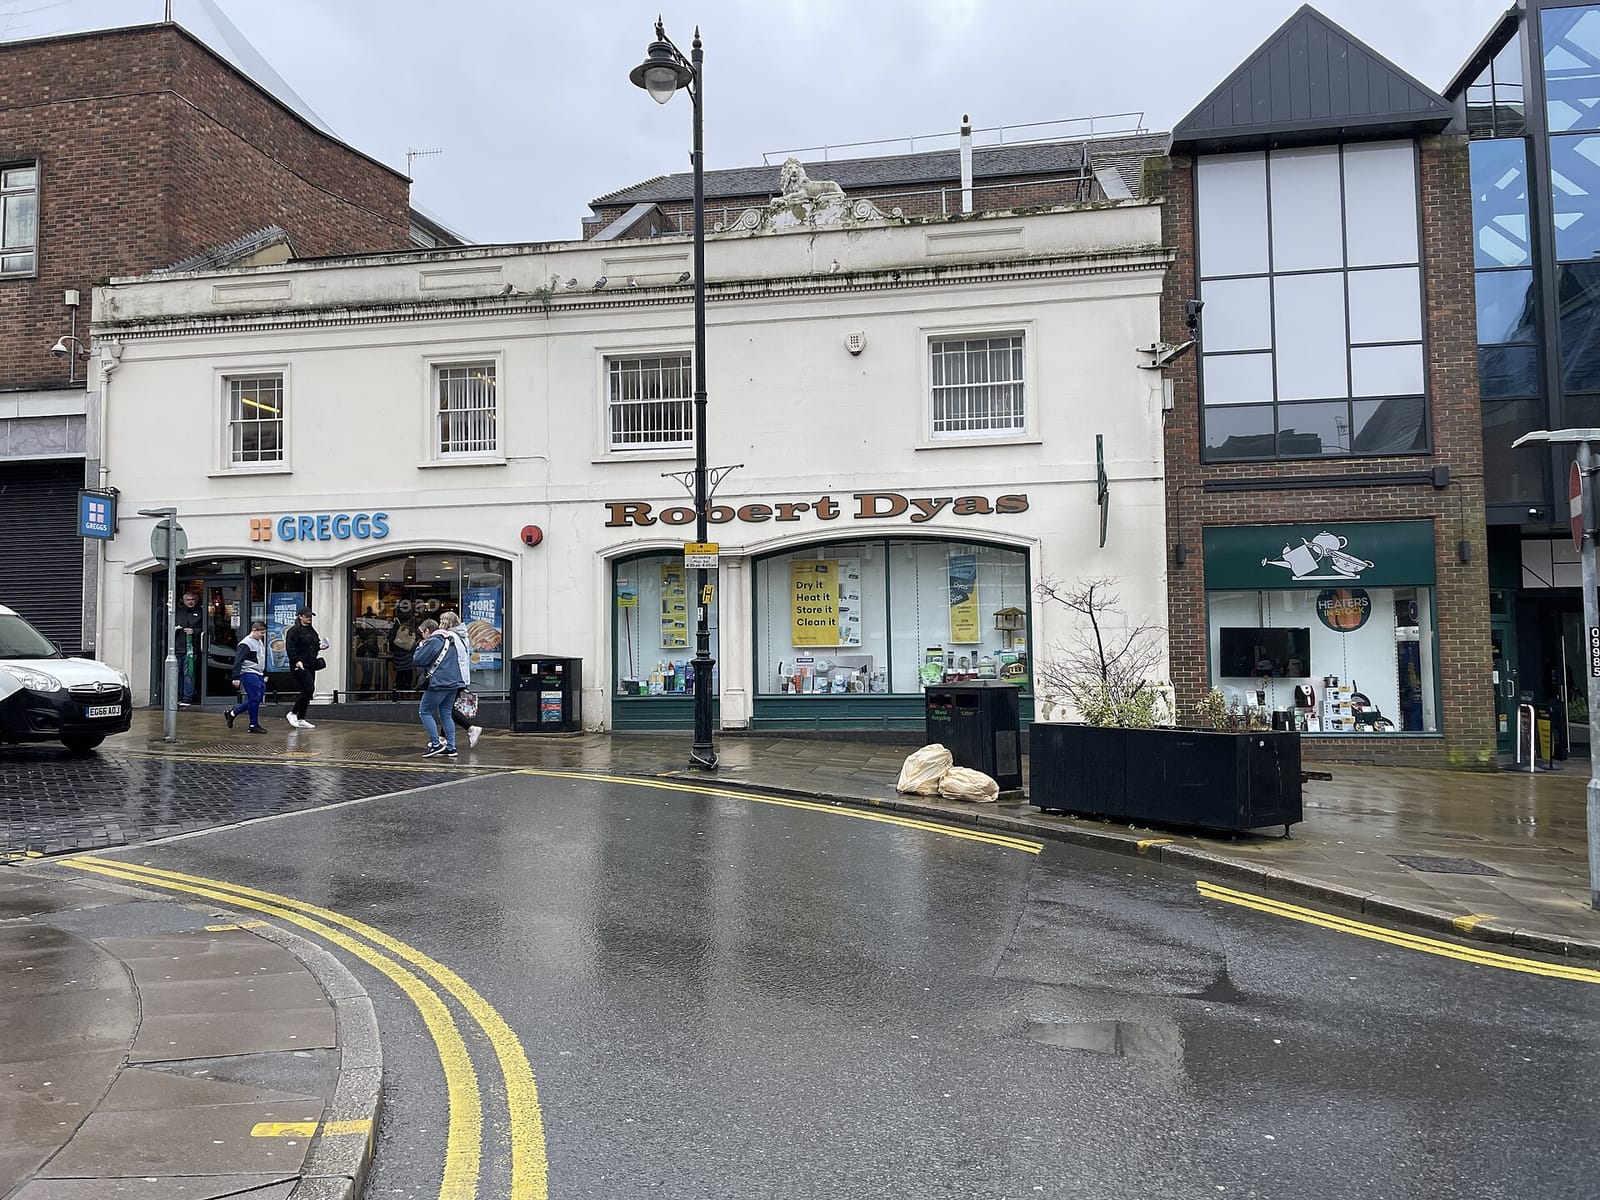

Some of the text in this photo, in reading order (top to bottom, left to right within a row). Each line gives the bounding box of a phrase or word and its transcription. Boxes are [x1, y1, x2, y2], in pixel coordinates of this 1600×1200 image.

[605, 493, 1030, 527] Robert Dyas
[85, 522, 108, 531] GREGGS
[277, 512, 389, 541] GREGGS
[796, 580, 823, 590] Dry it
[953, 581, 968, 590] Dyas
[796, 593, 830, 601] Heat it
[468, 600, 495, 612] MORE
[1318, 597, 1369, 610] HEATERS
[796, 605, 832, 614] Store it
[1323, 607, 1365, 617] IN STOCK
[796, 618, 836, 626] Clean it
